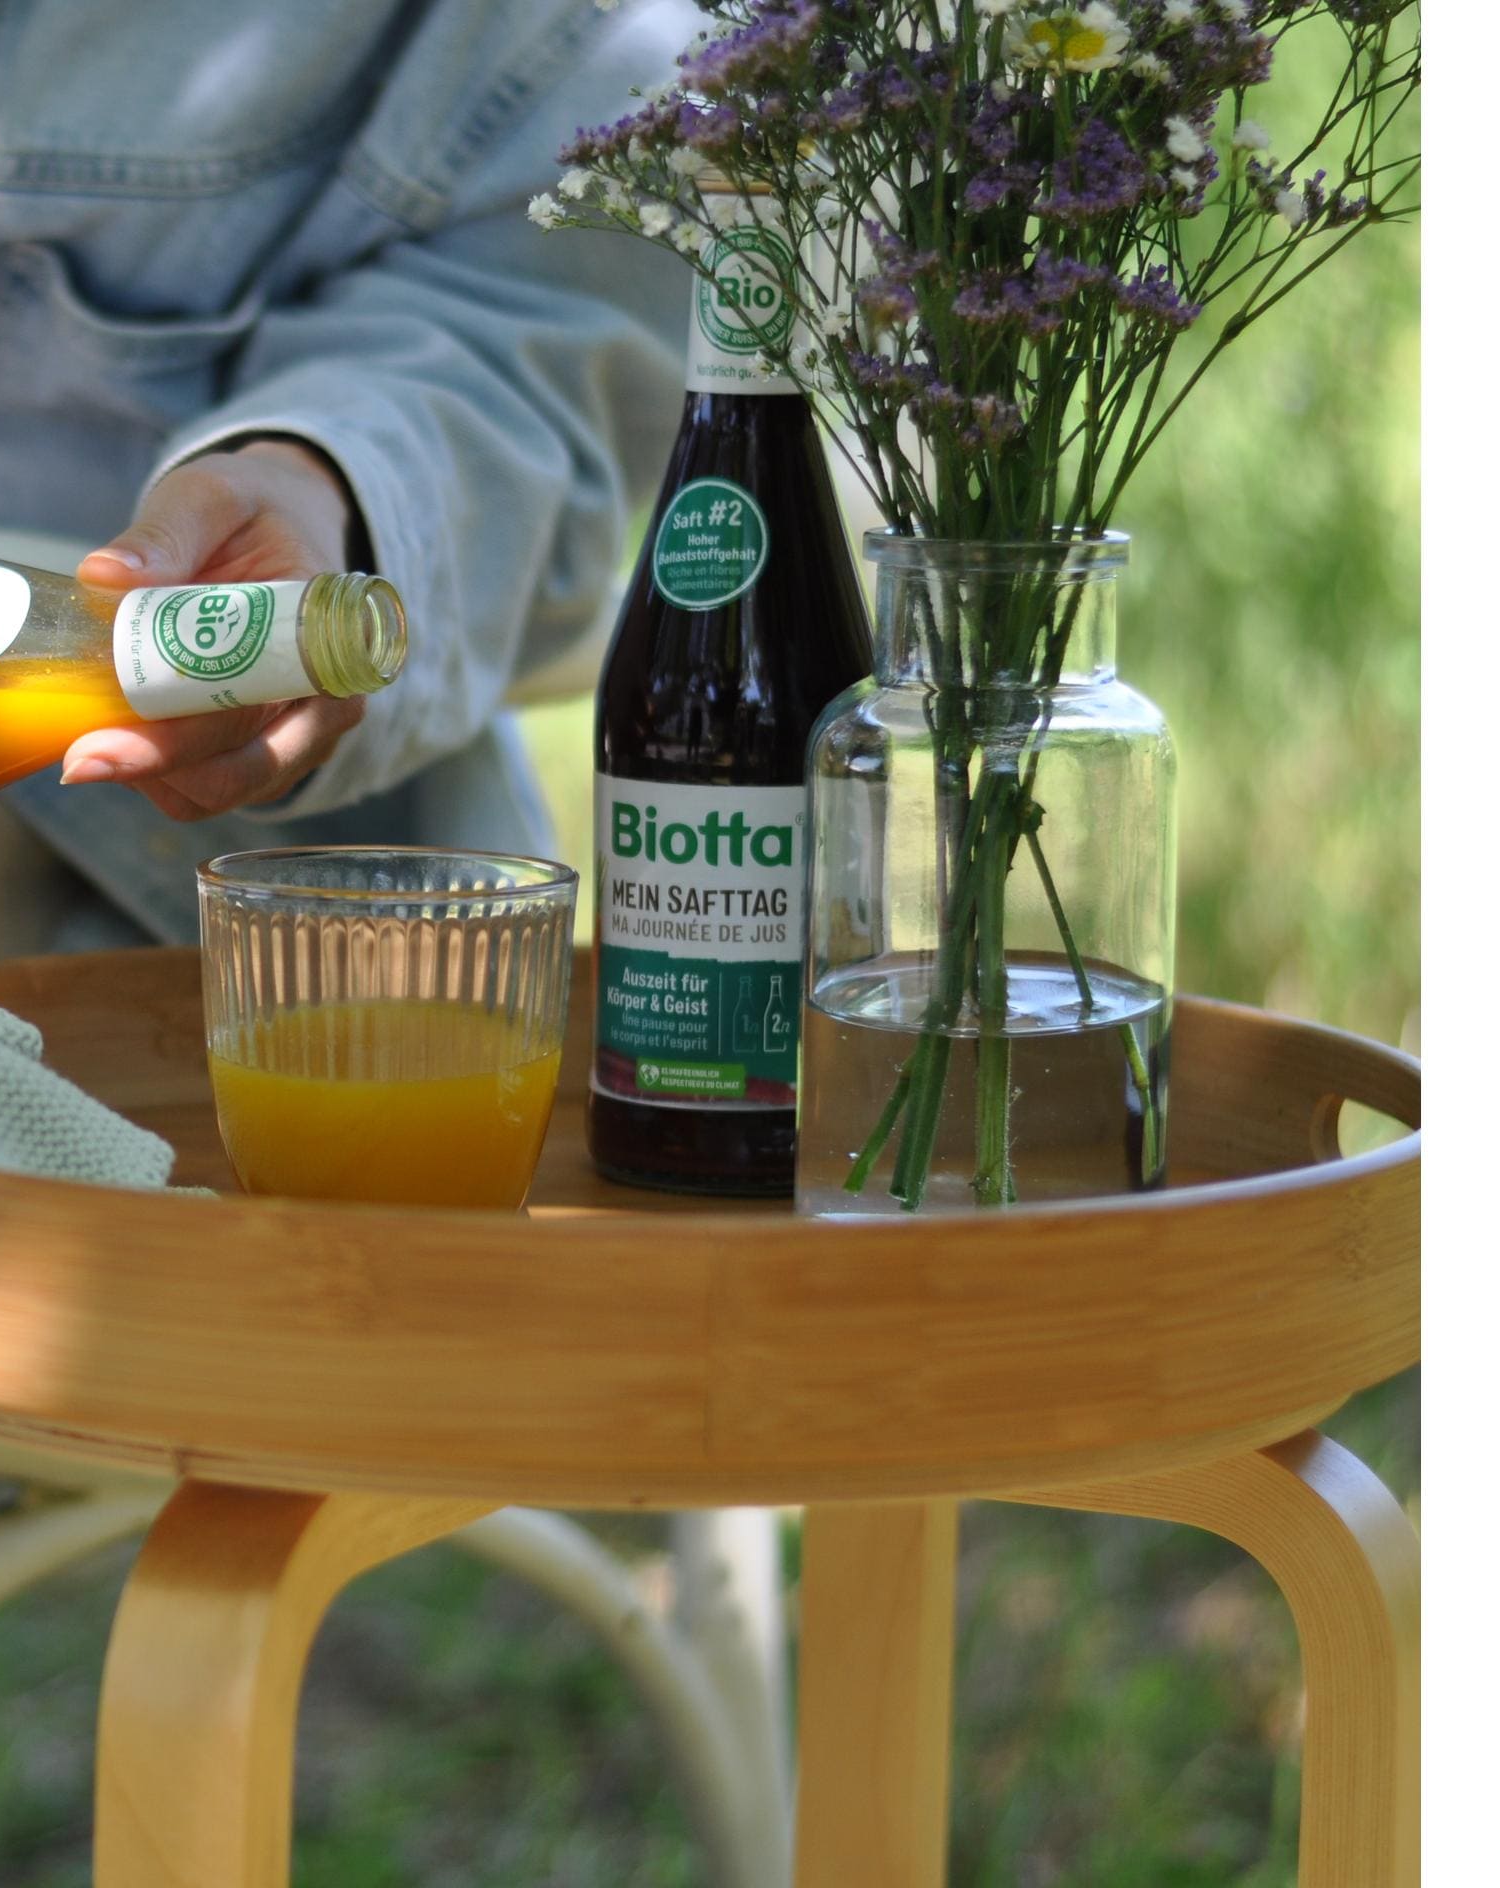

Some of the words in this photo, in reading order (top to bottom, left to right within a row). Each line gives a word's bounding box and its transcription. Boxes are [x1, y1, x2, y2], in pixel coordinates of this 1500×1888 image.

[717, 277, 775, 309] Bio
[731, 331, 761, 345] SUISS
[739, 367, 756, 381] gu
[672, 511, 703, 530] Saft
[708, 499, 743, 526] #2
[687, 534, 720, 546] Hoher
[131, 619, 143, 636] gut
[163, 608, 176, 644] SUISSE
[195, 594, 231, 650] Bio
[131, 640, 142, 656] für
[168, 641, 182, 656] DU
[179, 650, 196, 667] BIO
[221, 652, 241, 669] SEIT
[134, 659, 148, 687] mich.
[200, 659, 222, 672] 1957
[612, 801, 793, 867] Biotta
[612, 878, 659, 912] MEIN
[667, 885, 788, 917] SAFTTAG
[612, 914, 629, 934] MA
[633, 915, 711, 943] JOURNÉE
[719, 924, 743, 943] DE
[750, 923, 787, 943] JUS
[622, 967, 677, 991] Auszeit
[681, 973, 709, 992] für
[606, 986, 647, 1010] Körper
[649, 996, 660, 1013] &
[664, 995, 709, 1016] Geist
[622, 1013, 640, 1026] Une
[641, 1017, 676, 1034] pause
[678, 1021, 708, 1036] pour
[611, 1027, 619, 1038] le
[618, 1029, 647, 1046] corps
[648, 1033, 660, 1047] et
[663, 1034, 708, 1052] l'esprit
